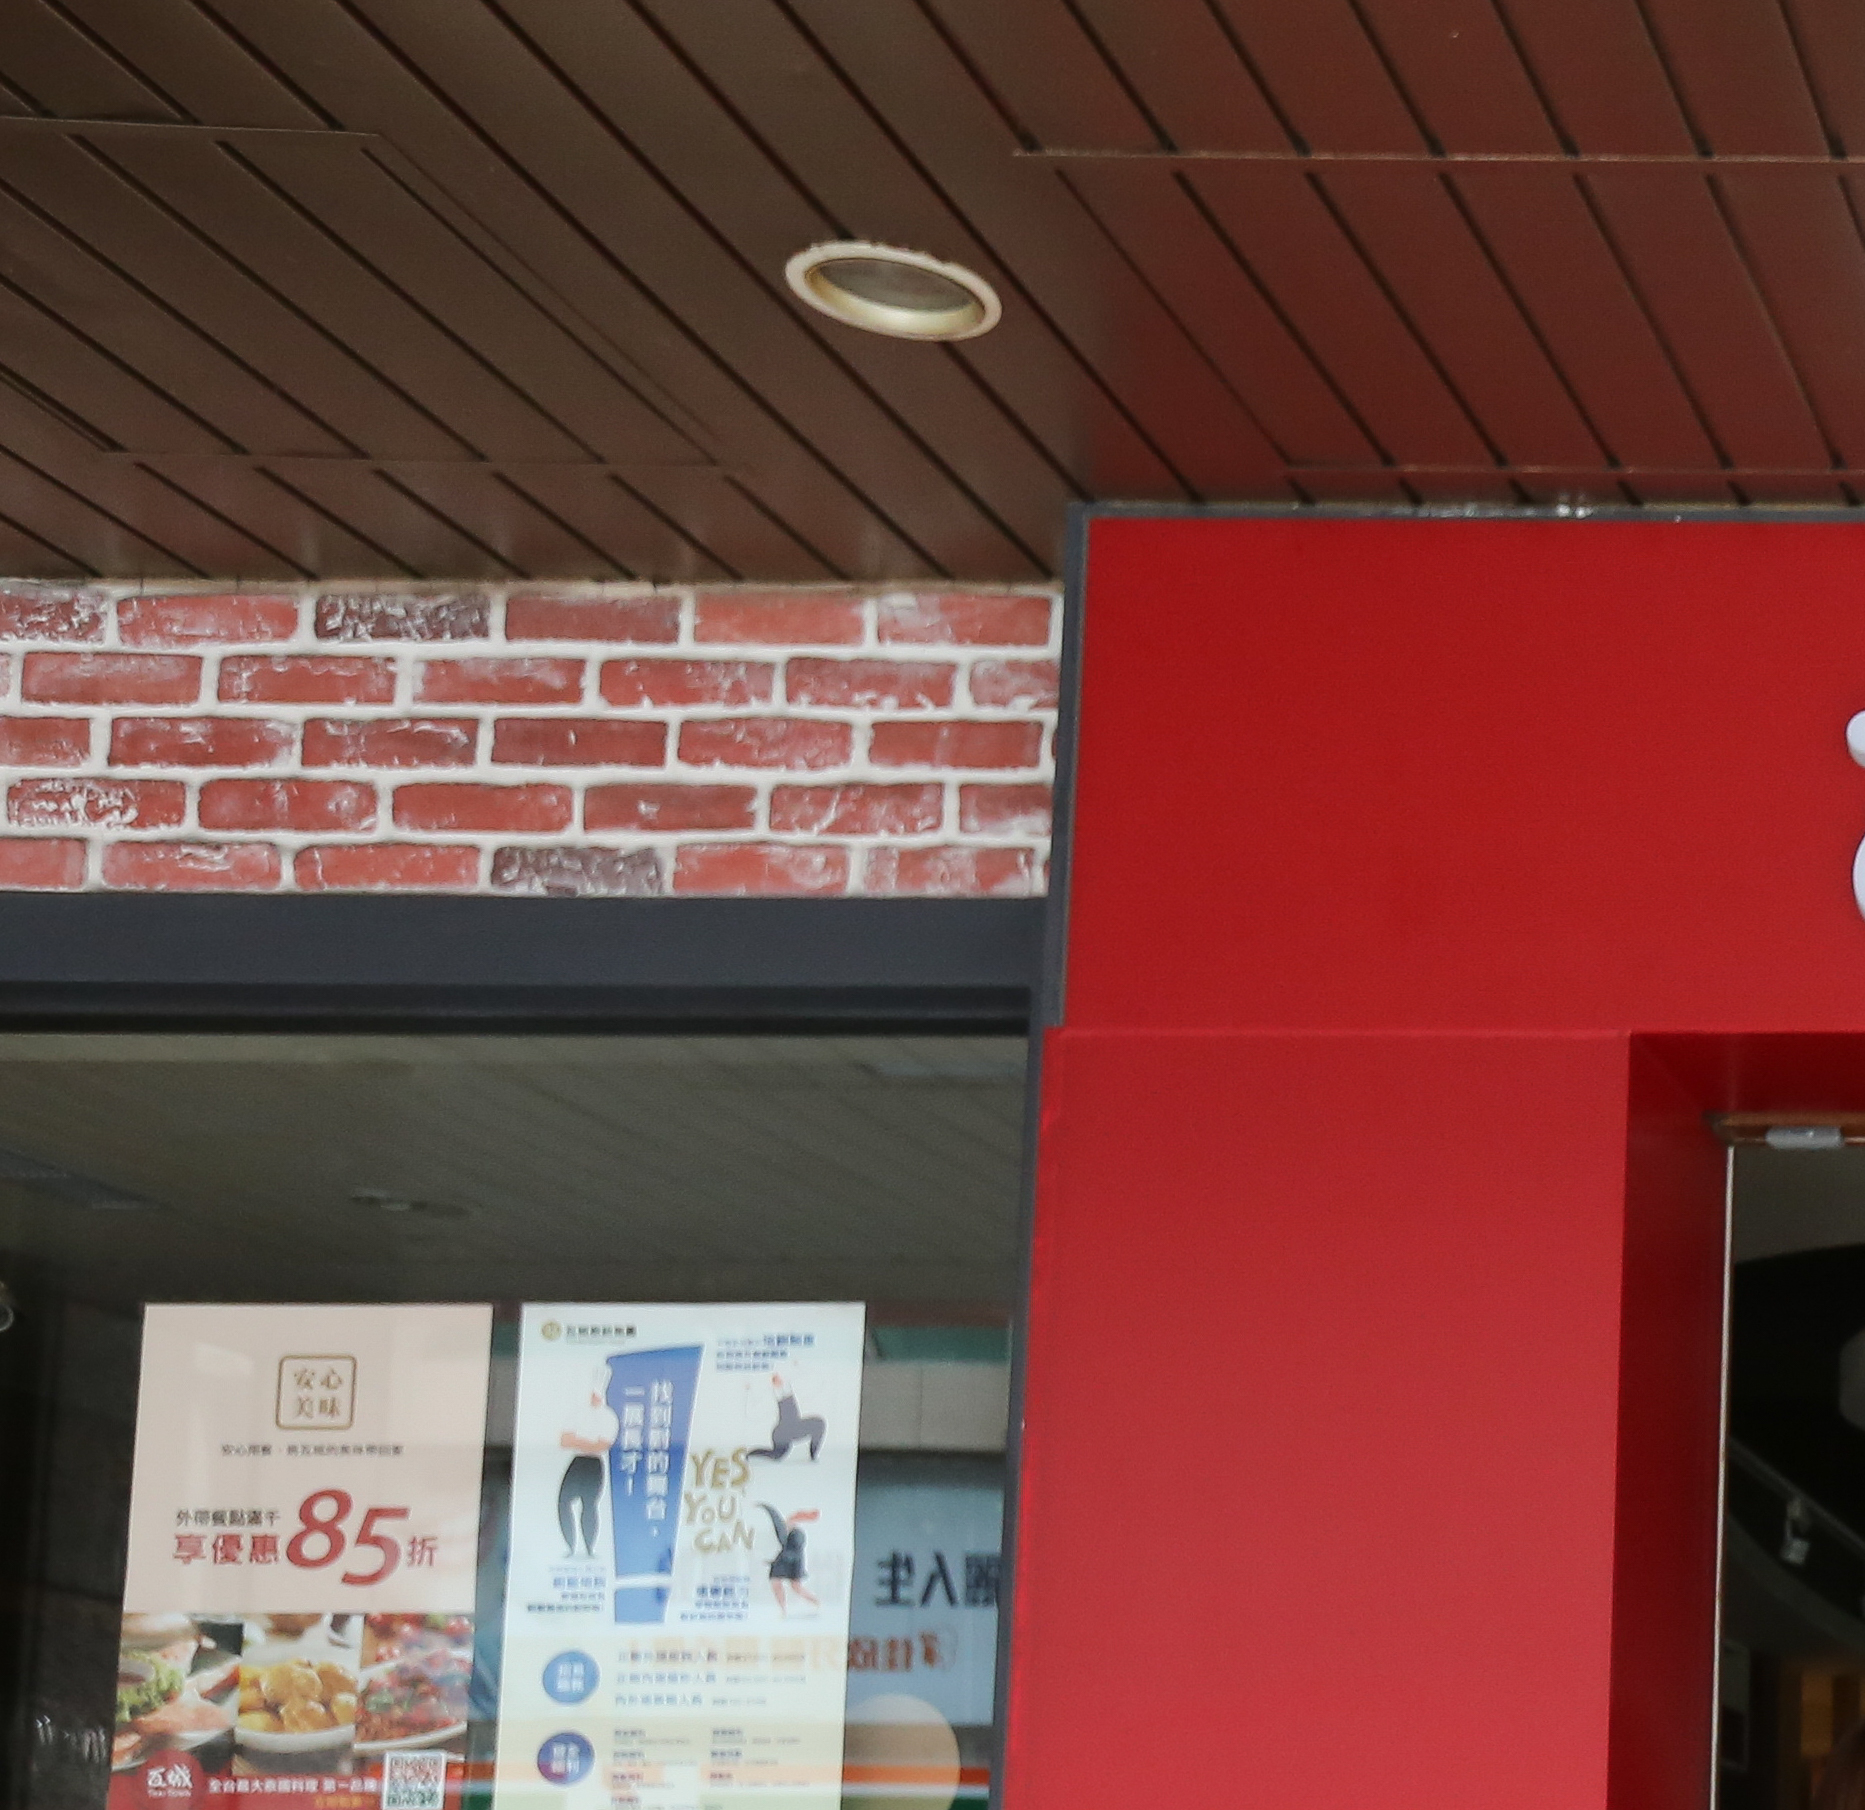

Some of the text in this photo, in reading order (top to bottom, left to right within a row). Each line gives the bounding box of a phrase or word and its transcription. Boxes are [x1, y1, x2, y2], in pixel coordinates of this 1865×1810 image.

[293, 1368, 344, 1390] 安心
[293, 1395, 341, 1418] 美味
[690, 1448, 750, 1489] YES
[146, 1765, 194, 1788] 瓦城
